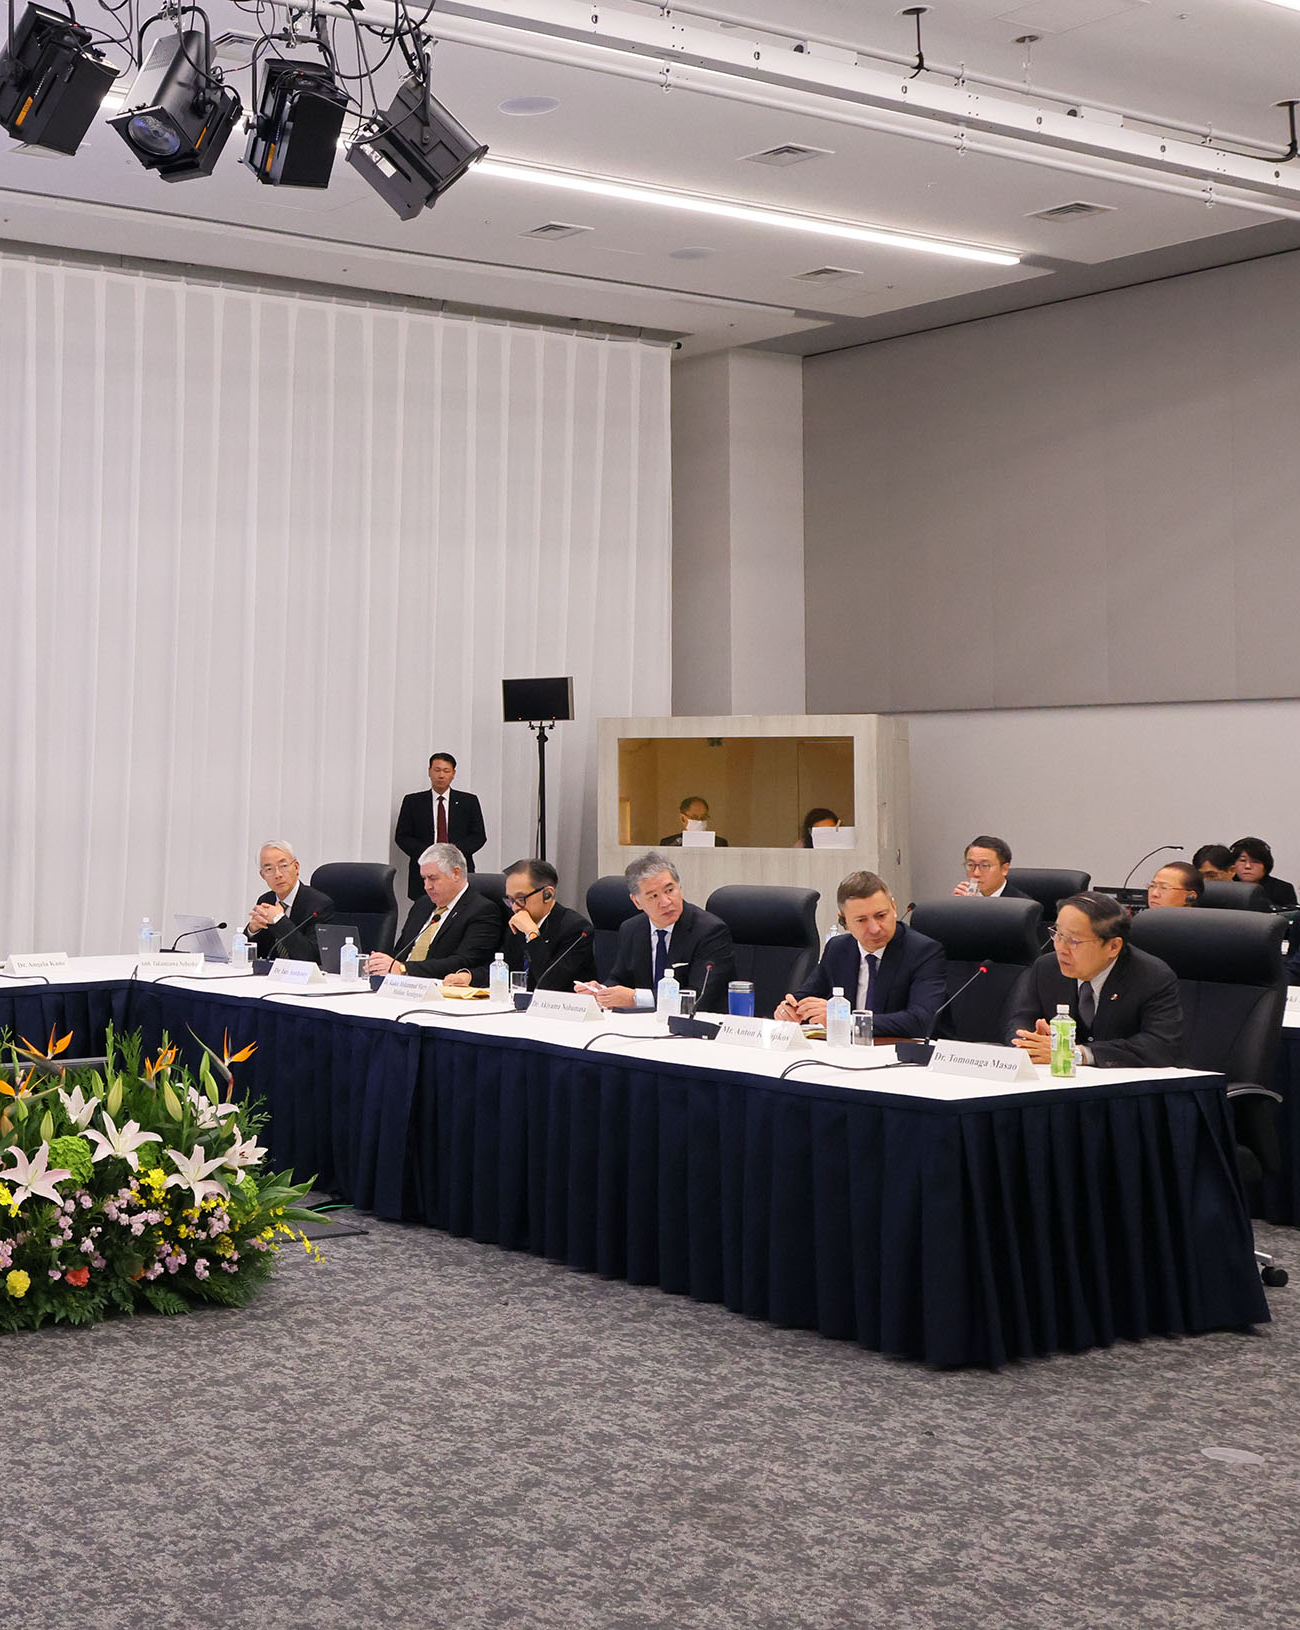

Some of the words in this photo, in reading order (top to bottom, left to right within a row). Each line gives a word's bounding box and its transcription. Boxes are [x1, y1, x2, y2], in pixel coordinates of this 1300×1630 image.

[721, 1025, 733, 1034] Mr.
[934, 1052, 946, 1062] Dr.
[949, 1053, 989, 1067] Tomonaga
[990, 1059, 1018, 1071] Masao
